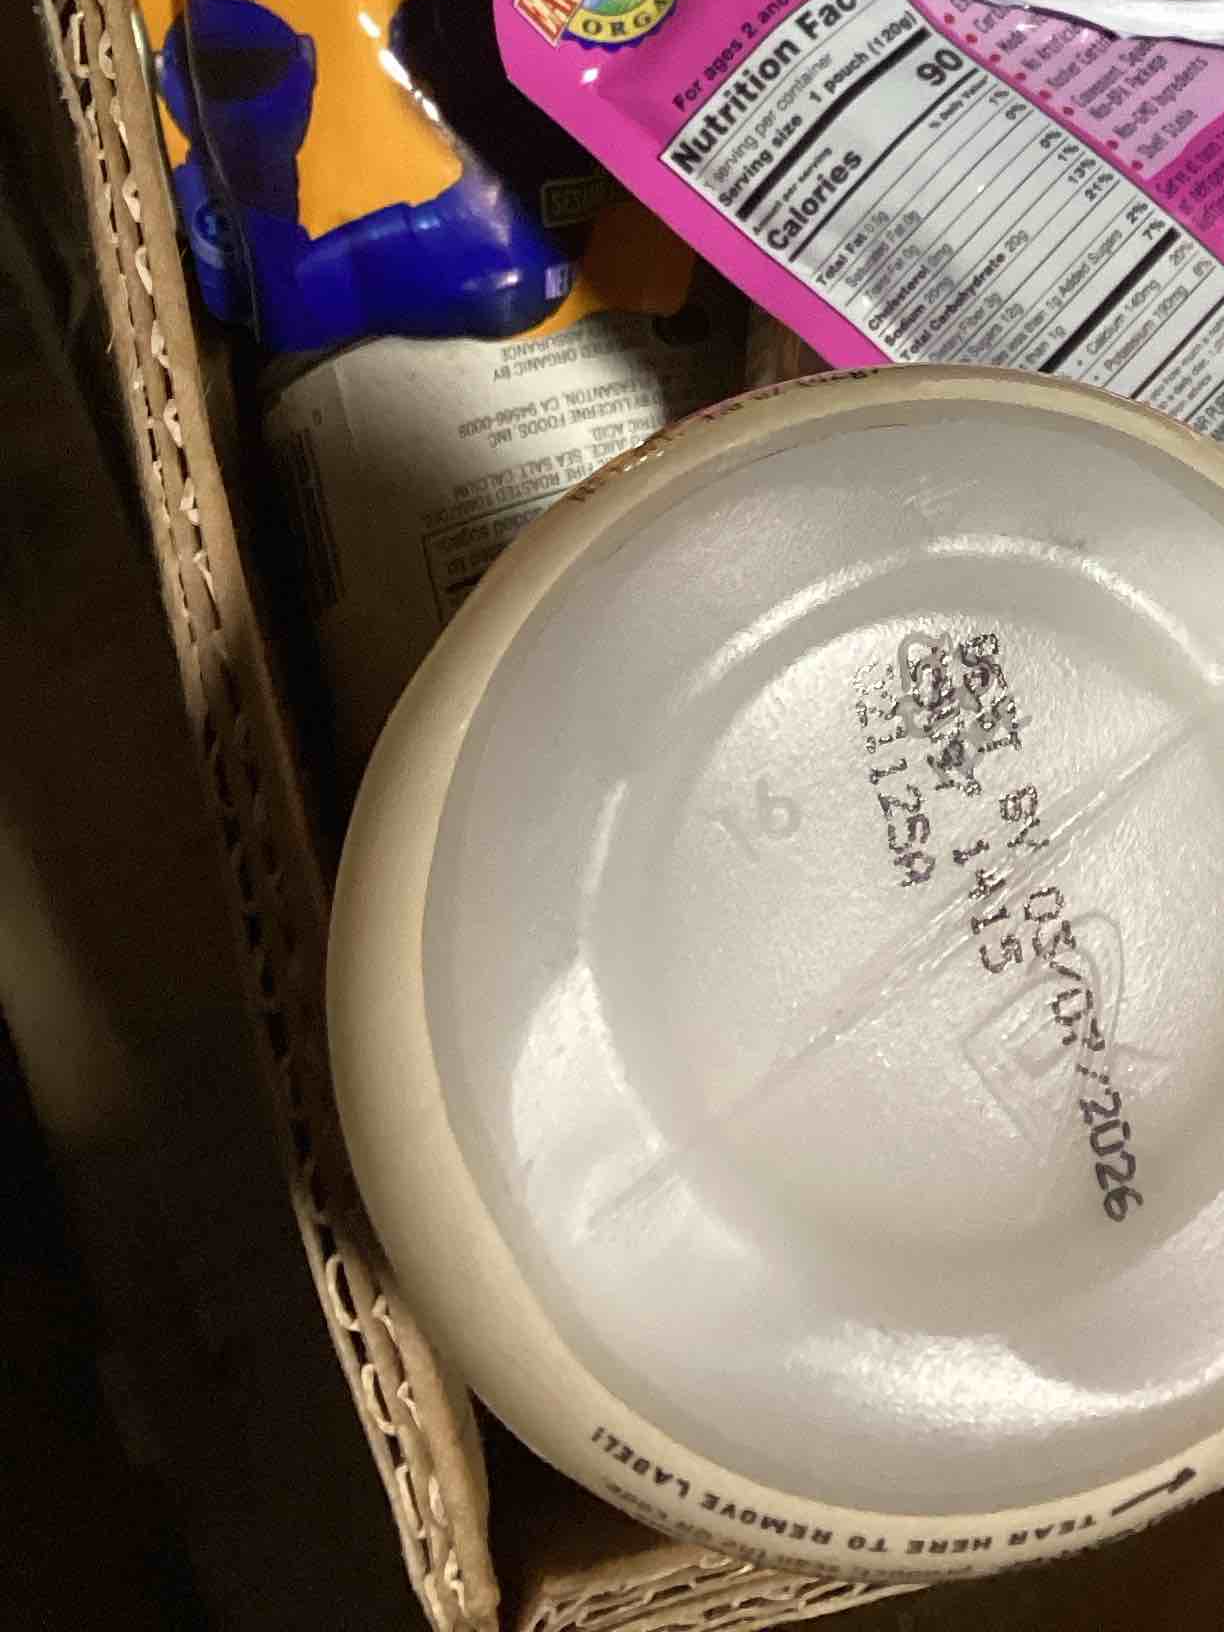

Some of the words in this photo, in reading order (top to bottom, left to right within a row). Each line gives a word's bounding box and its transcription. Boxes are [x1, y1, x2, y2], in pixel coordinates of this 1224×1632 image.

[668, 76, 708, 114] For
[698, 35, 748, 83] ages
[737, 17, 761, 41] 2
[750, 106, 784, 140] per
[770, 49, 839, 114] container
[658, 33, 814, 179] Nutrition
[711, 145, 780, 211] Serving
[765, 110, 807, 150] size
[806, 89, 823, 107] 1
[820, 47, 873, 98] pouch
[863, 6, 920, 60] (120g)
[755, 144, 874, 257] Calories
[911, 40, 967, 95] 90
[1081, 167, 1117, 204] 21%
[1123, 198, 1151, 226] 2%
[812, 250, 850, 289] Total
[841, 229, 869, 258] Fat
[899, 326, 936, 365] Total
[928, 247, 1010, 335] Carbohydrate
[1001, 226, 1032, 257] 20g
[1064, 152, 1099, 189] 13%
[1140, 215, 1169, 244] 7%
[864, 261, 933, 335] Cholesterol
[882, 299, 929, 350] Sodium
[588, 1424, 691, 1500] LABEL!
[700, 1490, 832, 1545] REMOVE
[847, 1533, 887, 1553] TO
[906, 1534, 992, 1555] HERE
[1007, 1512, 1096, 1549] TEAR
